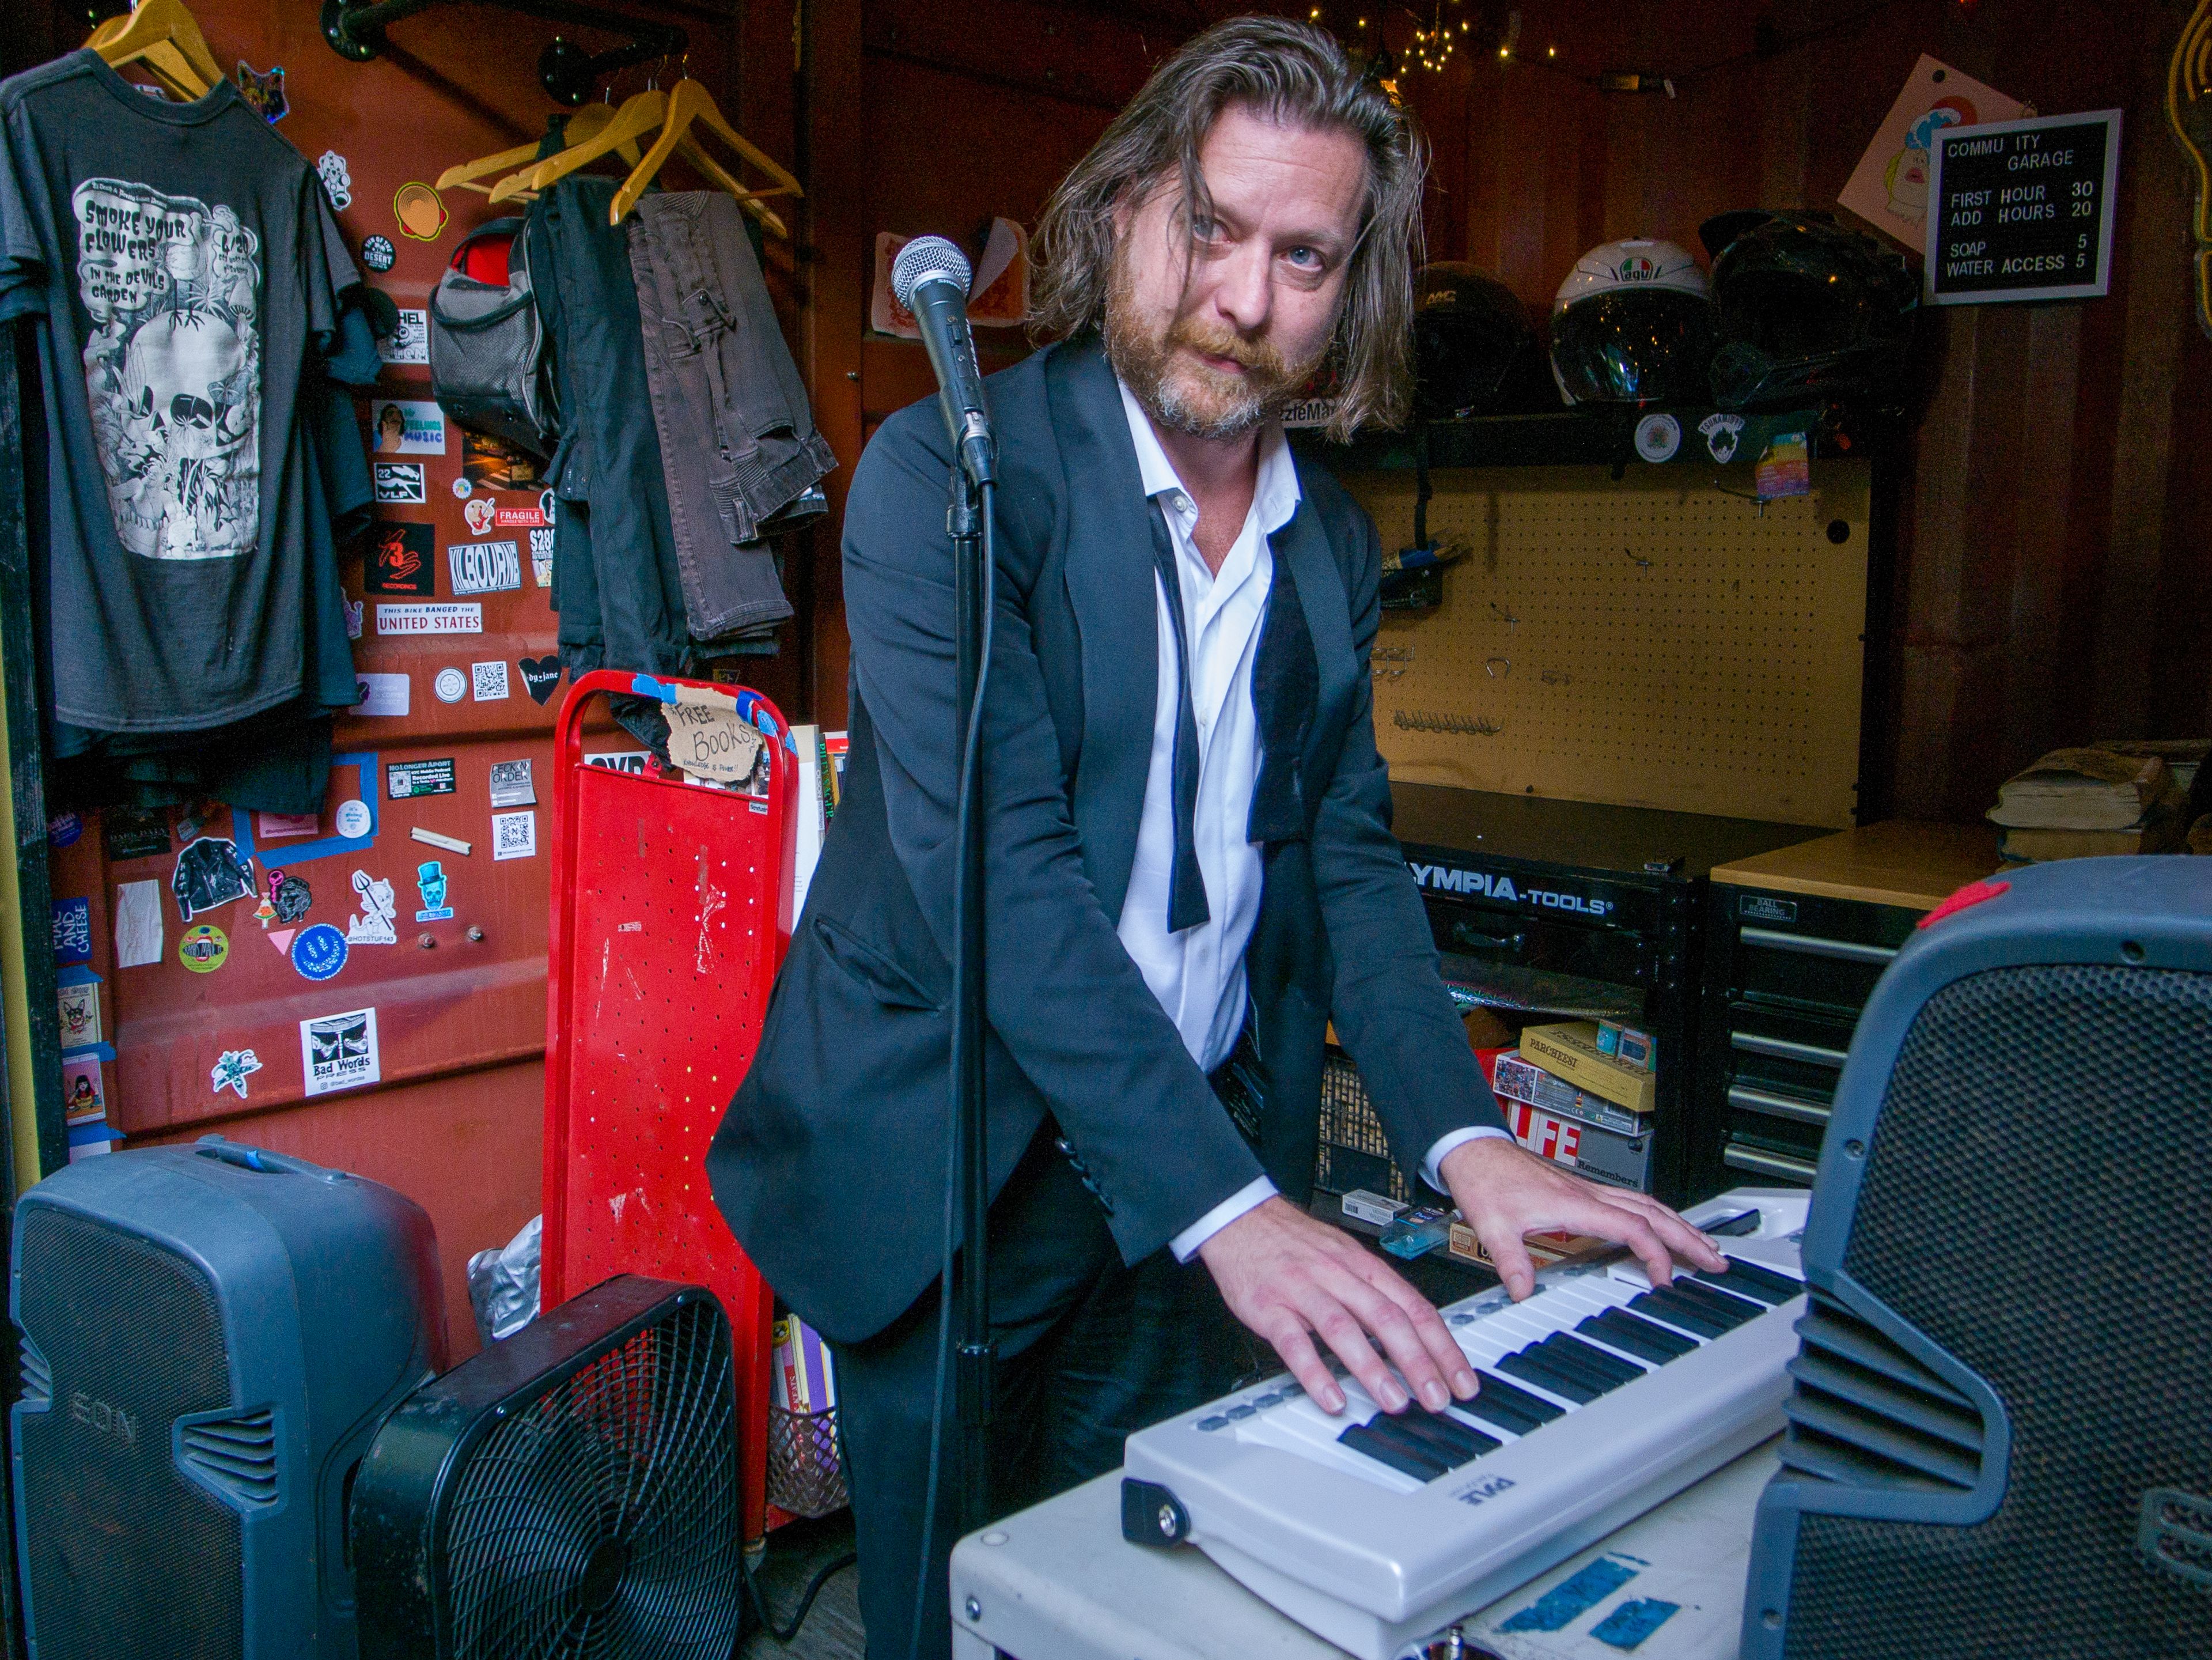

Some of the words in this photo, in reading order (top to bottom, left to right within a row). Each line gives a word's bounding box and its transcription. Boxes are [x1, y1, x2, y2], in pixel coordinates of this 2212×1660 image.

[2008, 149, 2074, 171] GARAGE
[1951, 190, 1992, 209] FIRST
[2001, 185, 2045, 204] HOUR
[2071, 180, 2093, 197] 30
[85, 199, 141, 236] SMOKE
[145, 215, 186, 241] YOUR
[1951, 211, 1982, 226] ADD
[1998, 203, 2055, 224] HOURS
[2071, 201, 2092, 217] 20
[85, 228, 156, 260] FLOWERS
[222, 235, 248, 255] 4/20
[1950, 241, 1987, 258] SOAP
[2077, 233, 2087, 248] 5
[364, 251, 392, 265] DESERT
[1946, 260, 1994, 278] WATER
[2001, 254, 2065, 274] ACCESS
[2075, 253, 2086, 268] 5
[90, 266, 101, 280] IN
[104, 271, 120, 285] THE
[126, 267, 165, 290] DEVIL'S
[91, 285, 138, 304] GARDEN
[377, 468, 391, 479] 22
[500, 511, 540, 519] FRAGILE
[379, 617, 429, 631] UNITED
[434, 615, 479, 629] STATES
[674, 701, 715, 727] FREE
[63, 912, 76, 947] AND
[74, 904, 89, 952] CHEESE
[1529, 1038, 1578, 1068] PARCHEESI
[313, 1062, 334, 1076] Bad
[338, 1056, 370, 1071] Words
[316, 1067, 366, 1081] PRESS
[1577, 1159, 1639, 1189] Remembers
